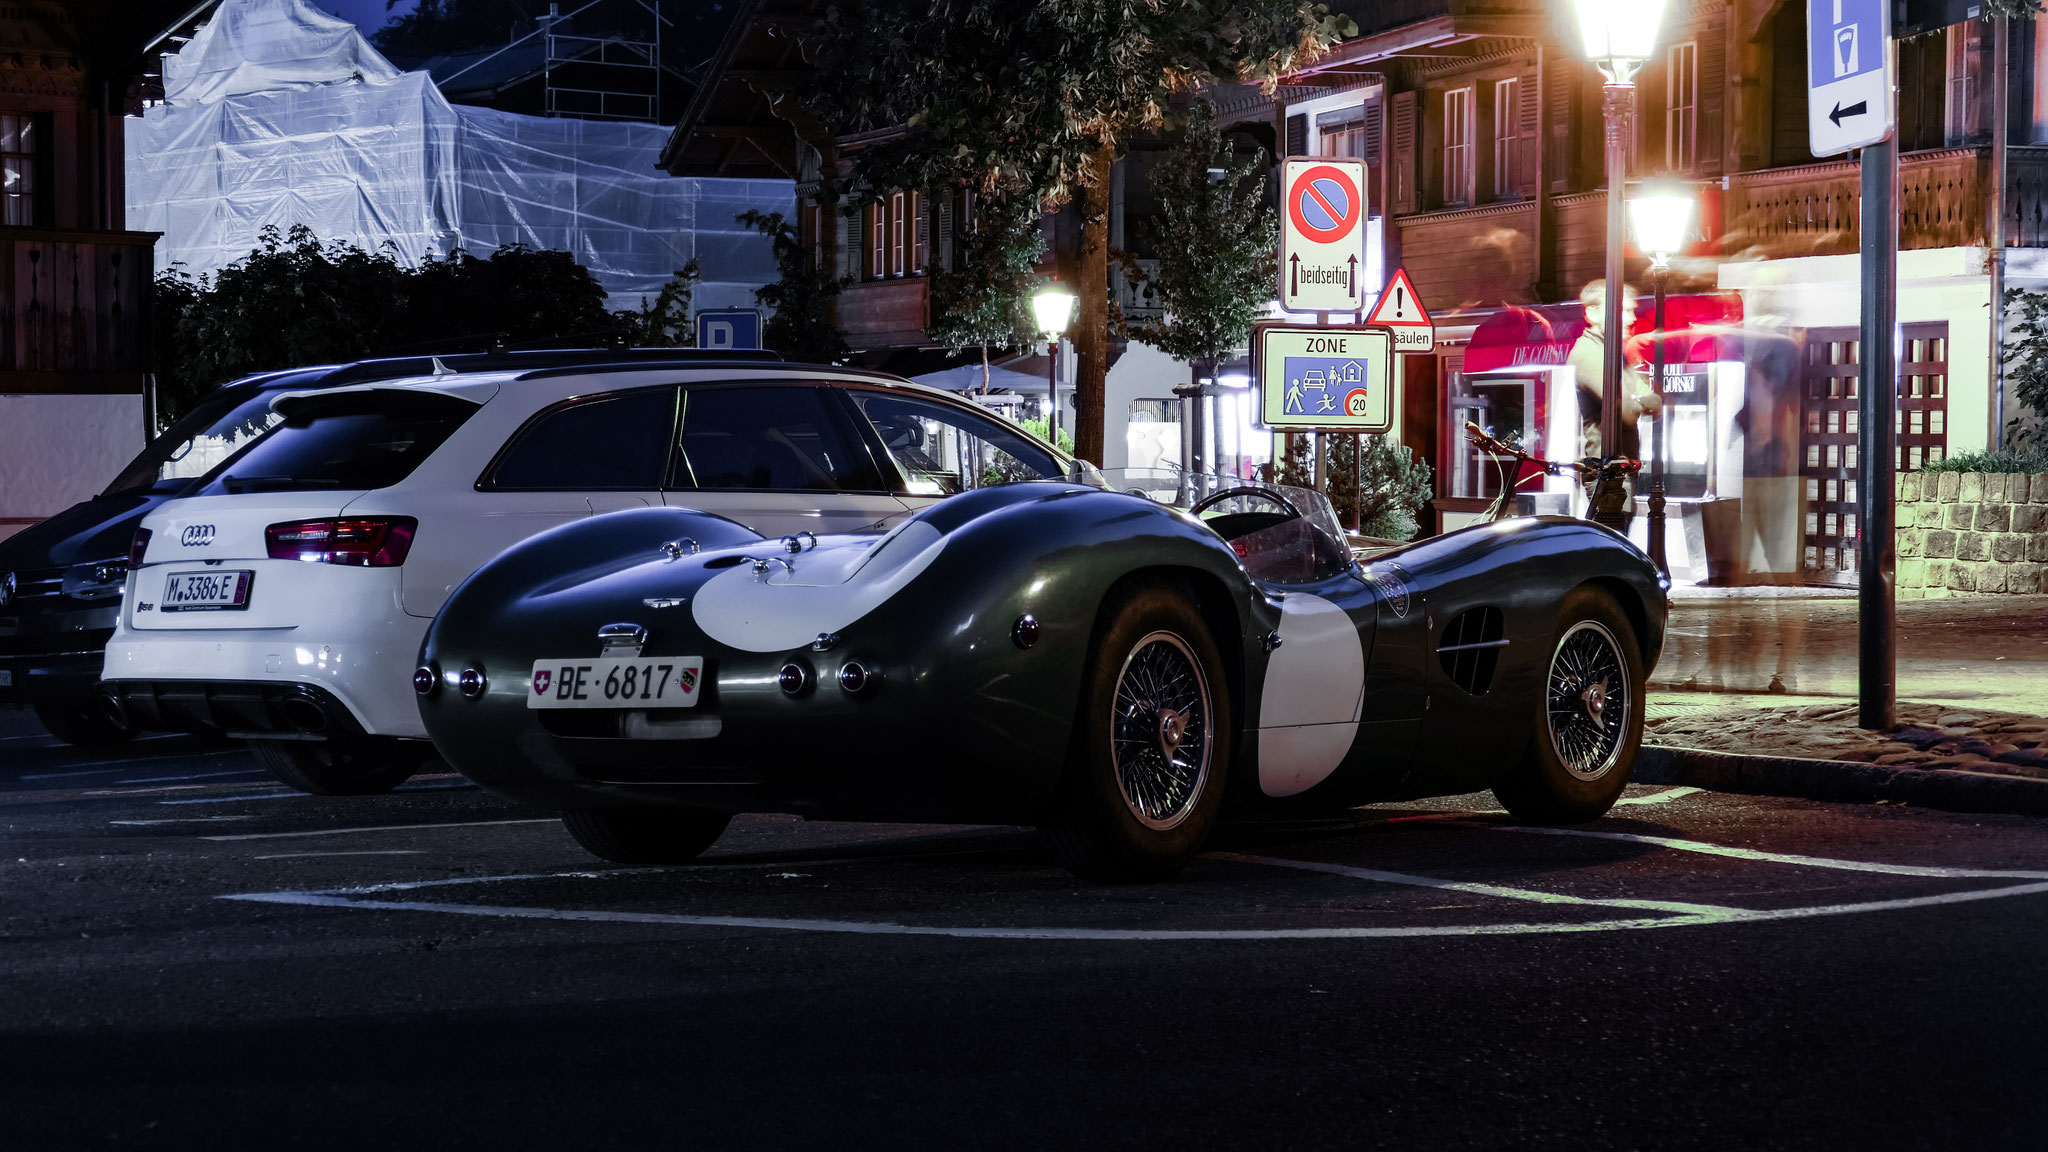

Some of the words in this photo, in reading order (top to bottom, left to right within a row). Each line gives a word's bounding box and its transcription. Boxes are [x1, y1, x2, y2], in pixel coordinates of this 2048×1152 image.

[1300, 264, 1348, 289] beidseitig
[1306, 338, 1347, 353] ZONE
[1663, 376, 1695, 392] GORSKI
[1352, 399, 1366, 411] 20
